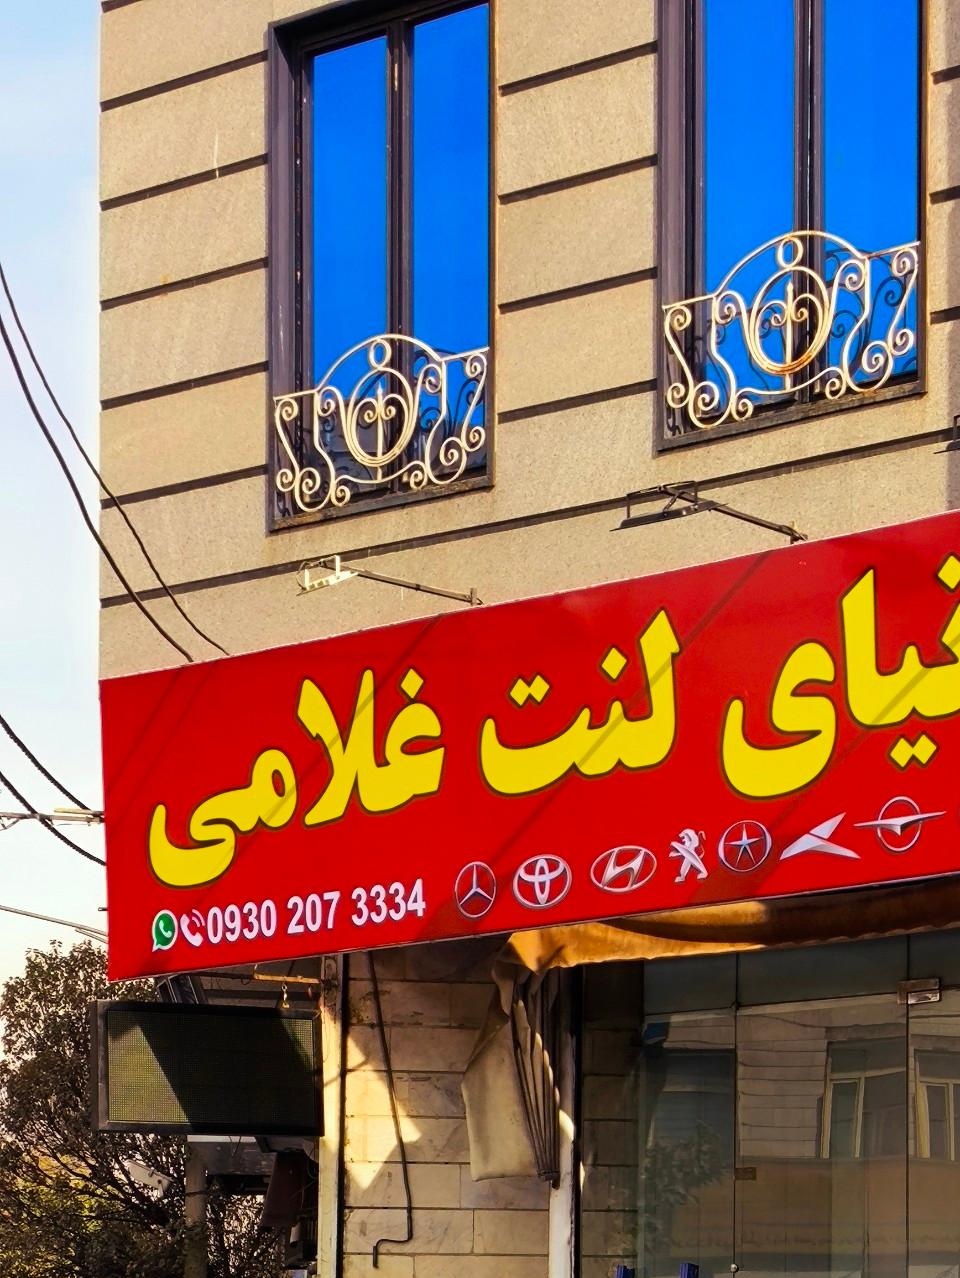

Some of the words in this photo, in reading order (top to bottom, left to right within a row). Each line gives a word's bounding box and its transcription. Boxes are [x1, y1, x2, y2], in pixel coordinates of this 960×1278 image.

[148, 667, 446, 887] غلامی
[480, 609, 681, 795] لنت
[206, 899, 278, 945] 0930
[286, 891, 341, 935] 207
[350, 877, 427, 927] 3334
